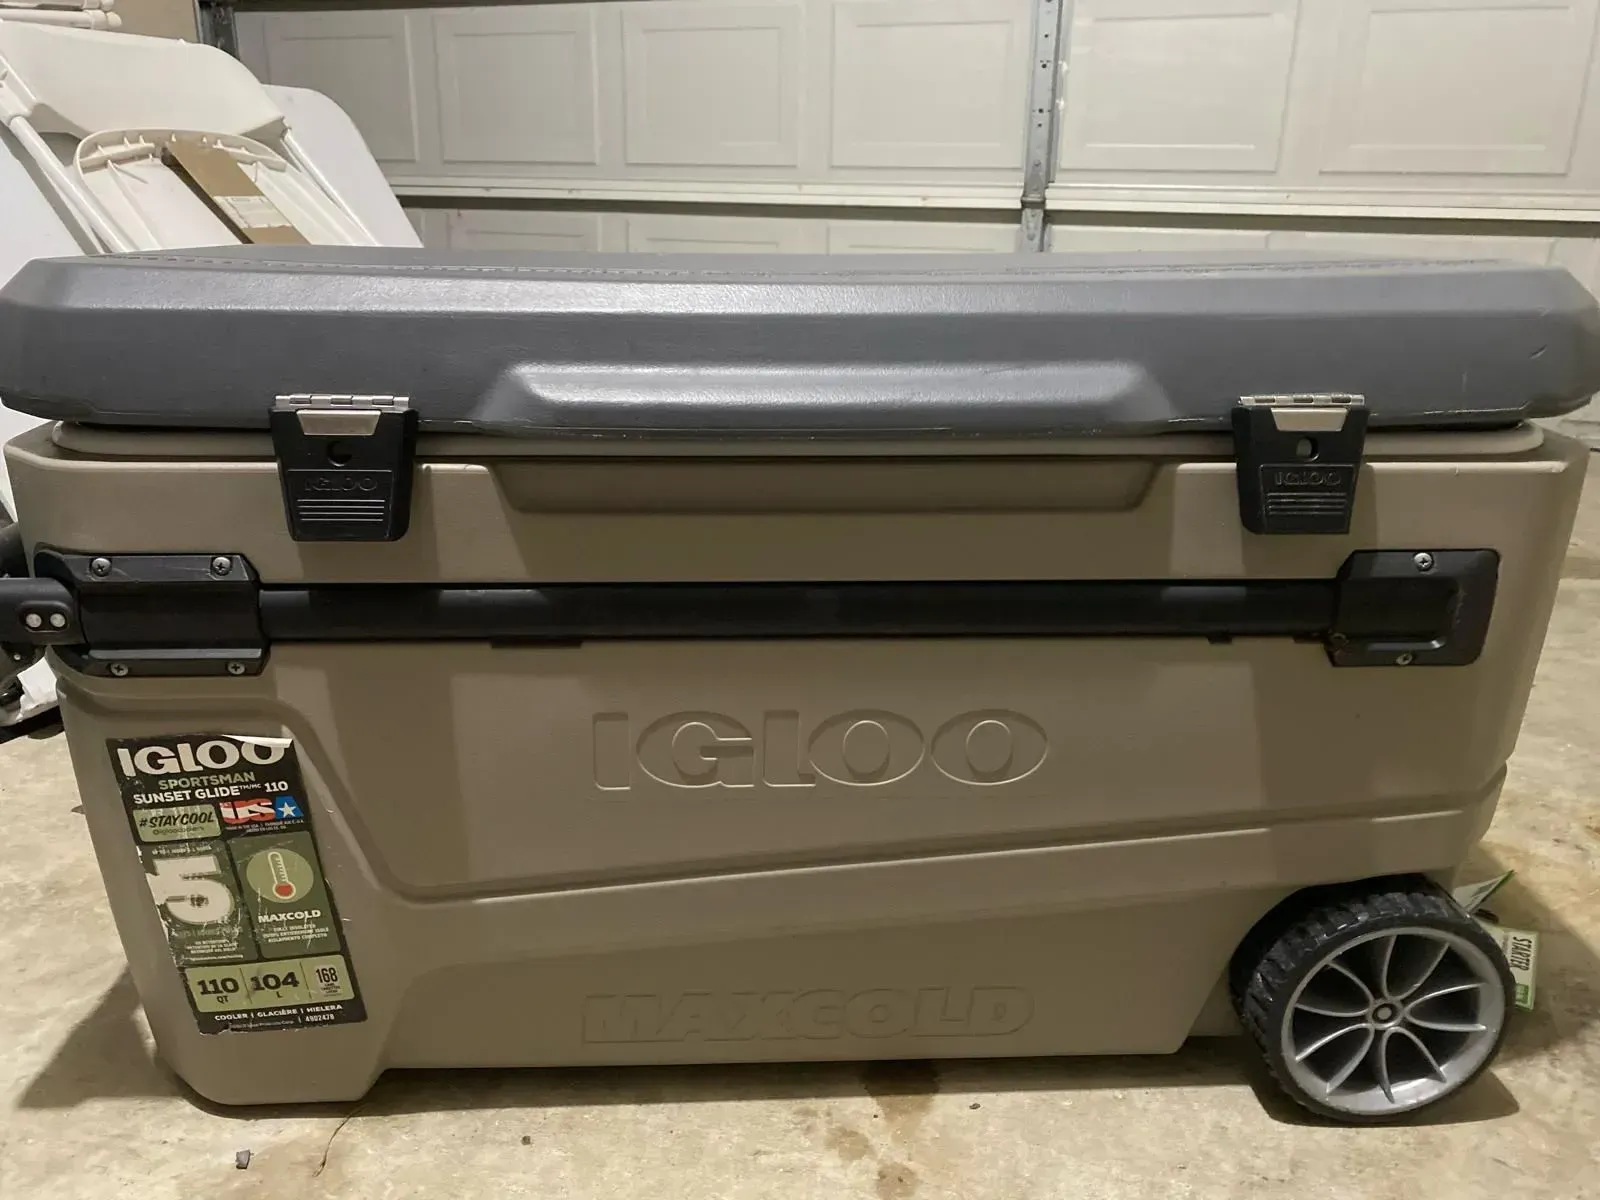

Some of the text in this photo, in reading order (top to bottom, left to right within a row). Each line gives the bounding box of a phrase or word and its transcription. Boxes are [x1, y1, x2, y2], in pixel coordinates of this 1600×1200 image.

[117, 740, 285, 777] IGLOO
[592, 708, 1049, 791] IGLOO
[158, 771, 256, 790] SPORTSMAN
[133, 789, 192, 805] SUNSET
[264, 781, 289, 793] 110
[257, 909, 322, 924] MAXCOLD
[250, 971, 299, 992] 104
[316, 967, 338, 983] 168
[197, 977, 240, 996] 110
[276, 991, 283, 999] L
[216, 995, 229, 1004] QT
[214, 1013, 248, 1021] COOLER
[581, 985, 1036, 1044] MAXCOLD
